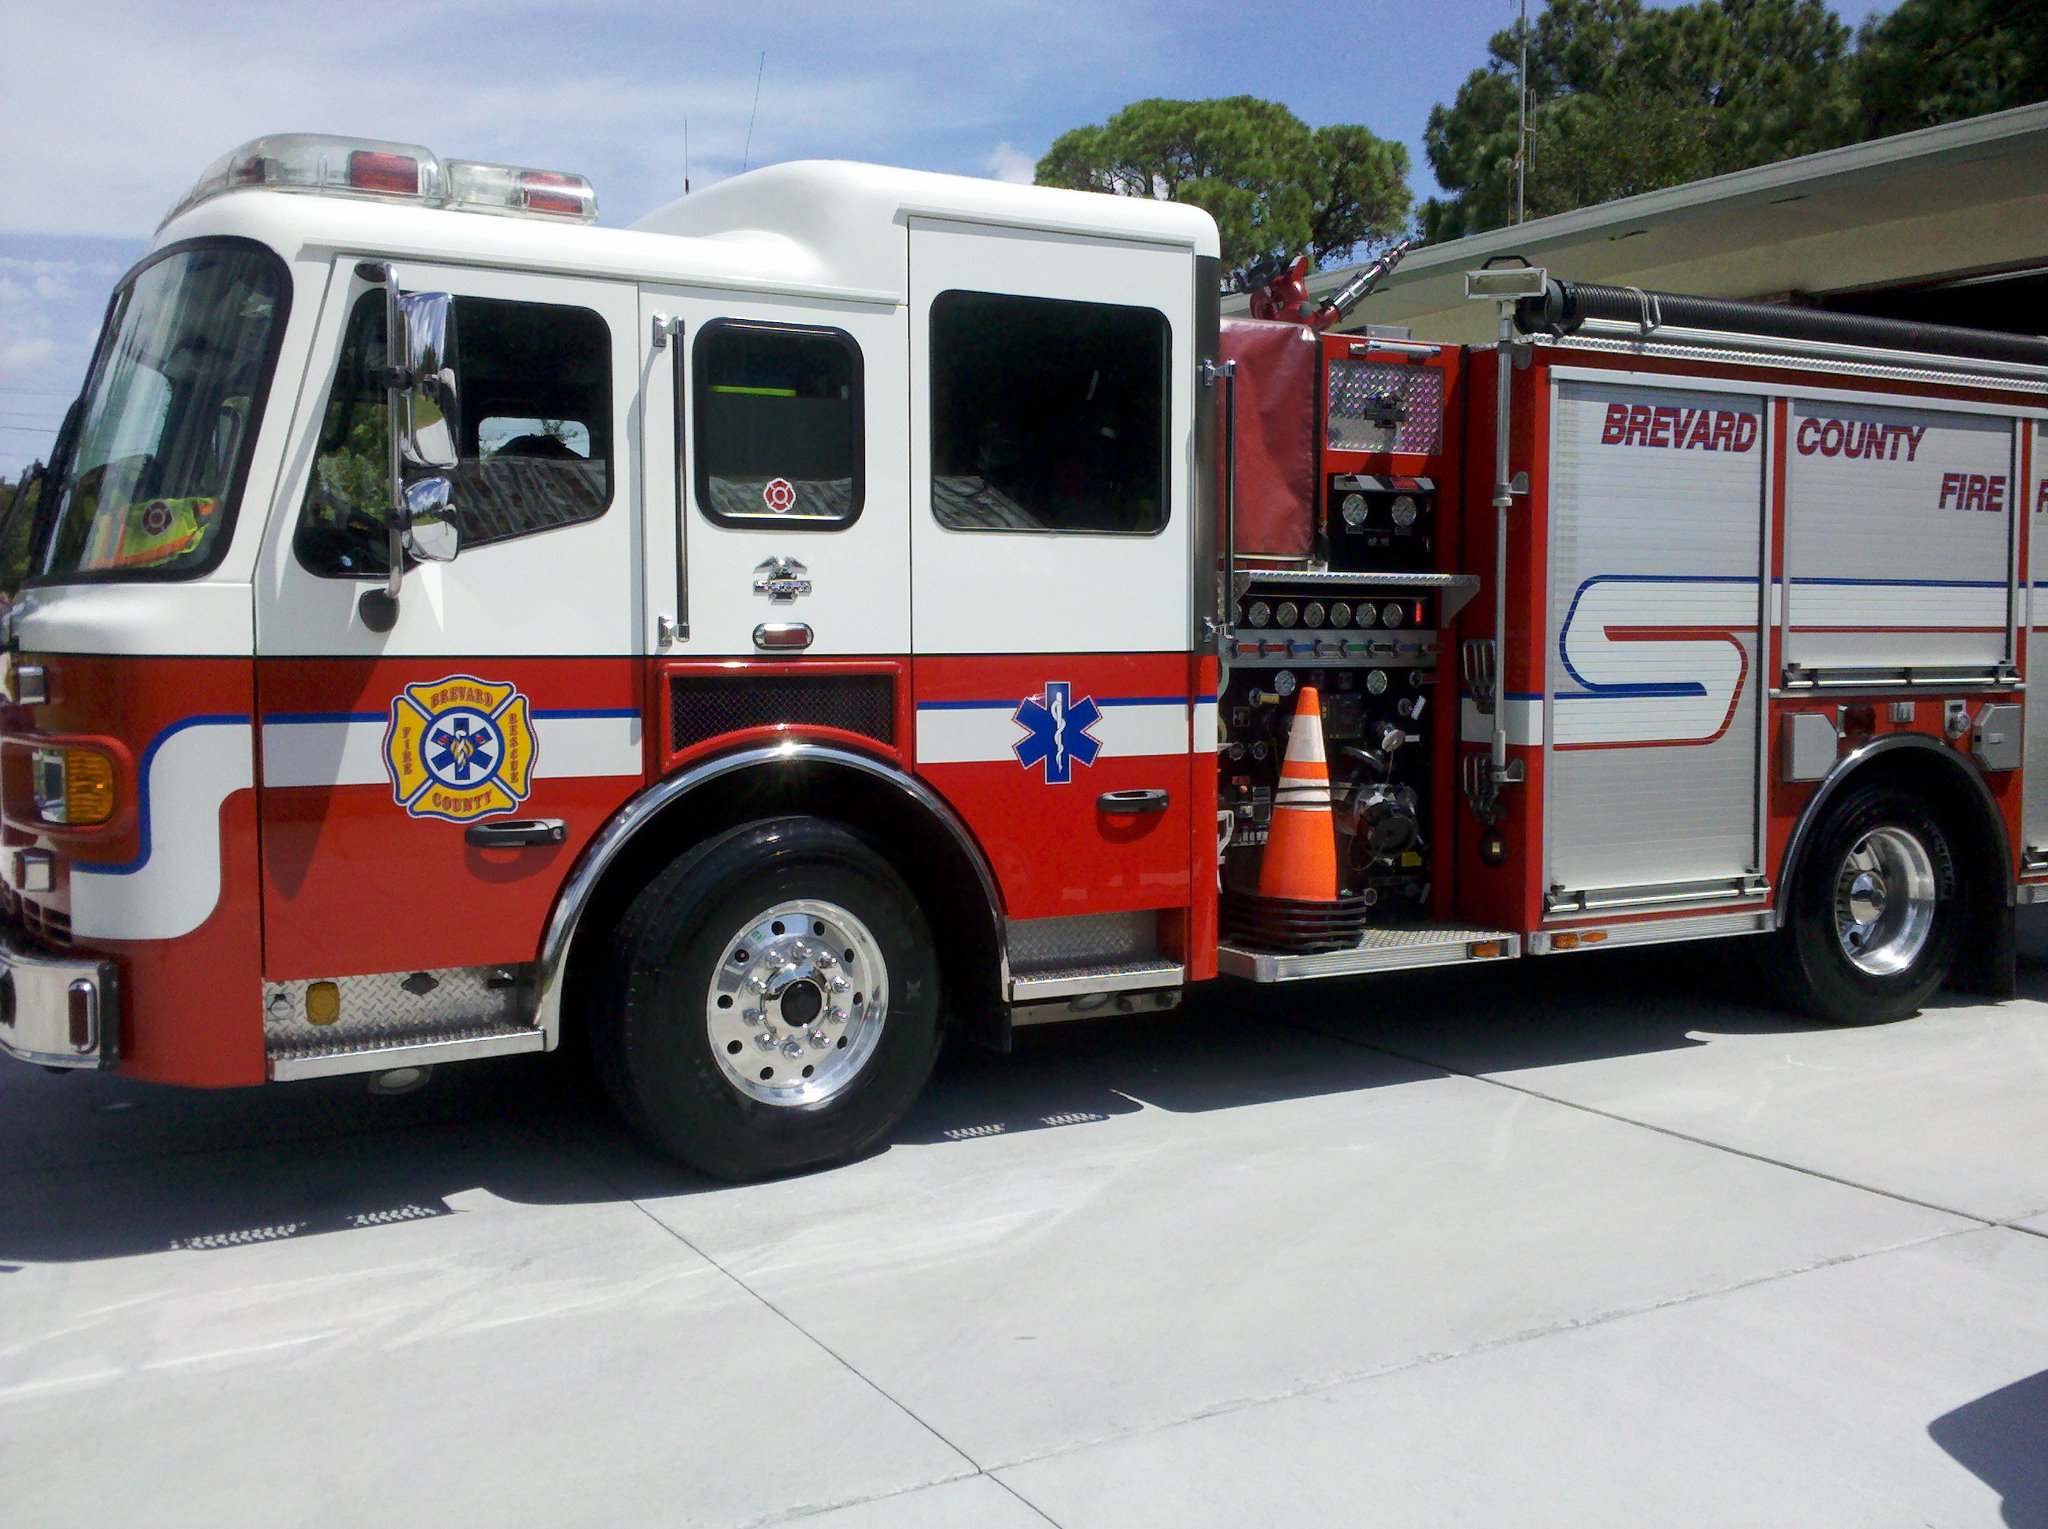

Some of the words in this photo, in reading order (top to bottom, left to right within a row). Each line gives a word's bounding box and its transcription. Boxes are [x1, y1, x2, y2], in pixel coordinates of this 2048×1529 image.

[1601, 403, 1758, 452] BREVARD
[1797, 417, 1928, 462] COUNTY
[1938, 472, 2006, 512] FIRE
[430, 686, 494, 709] BREVARD
[402, 727, 413, 776] FIRE
[508, 713, 519, 784] RESCUE
[431, 789, 493, 813] COUNTY
